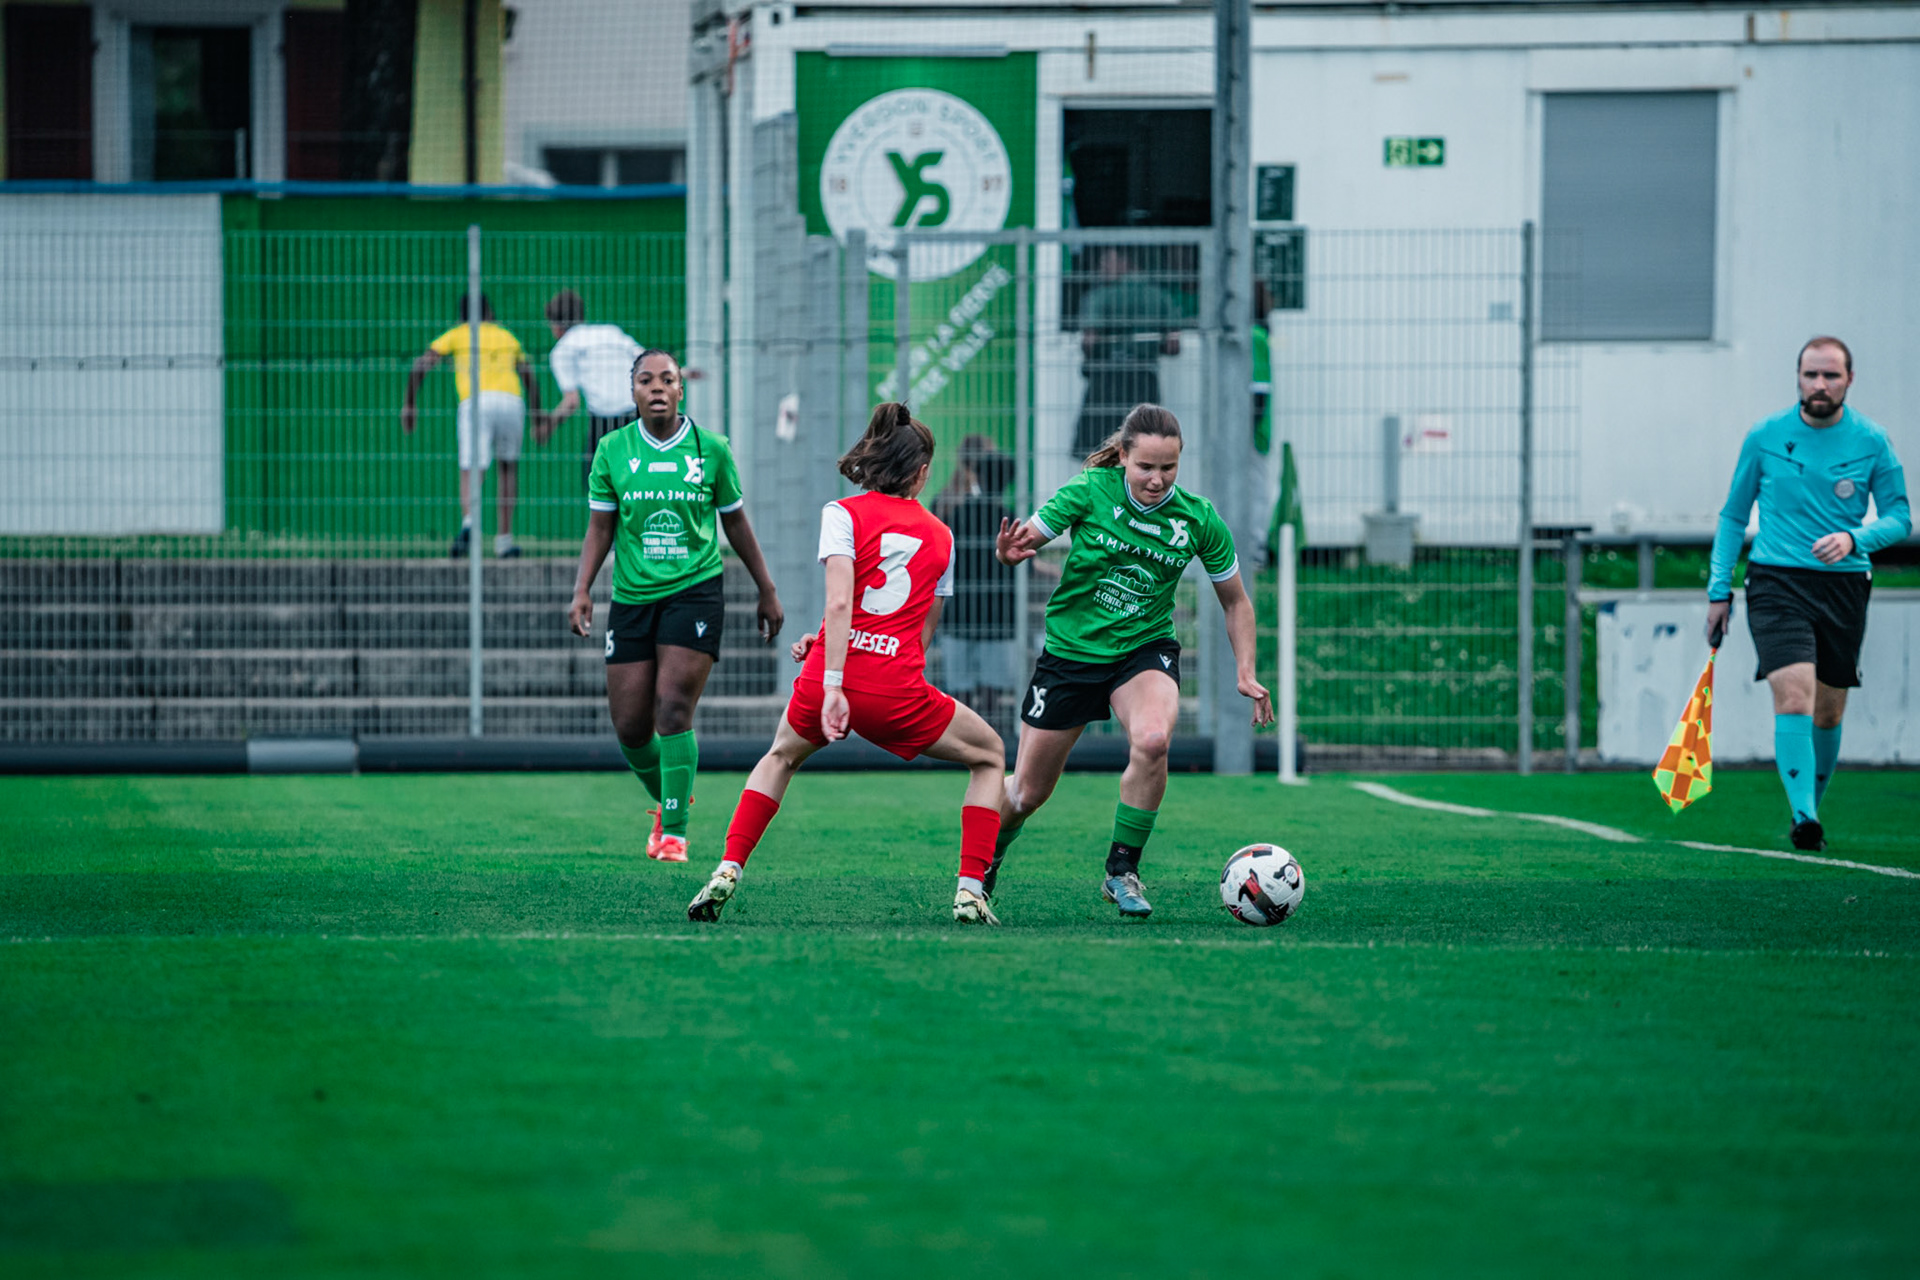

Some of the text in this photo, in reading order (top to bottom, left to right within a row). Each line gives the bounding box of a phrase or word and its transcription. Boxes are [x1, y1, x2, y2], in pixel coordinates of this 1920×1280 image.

[860, 532, 924, 616] 3
[1100, 592, 1124, 609] CENTRE
[665, 798, 678, 810] 23
